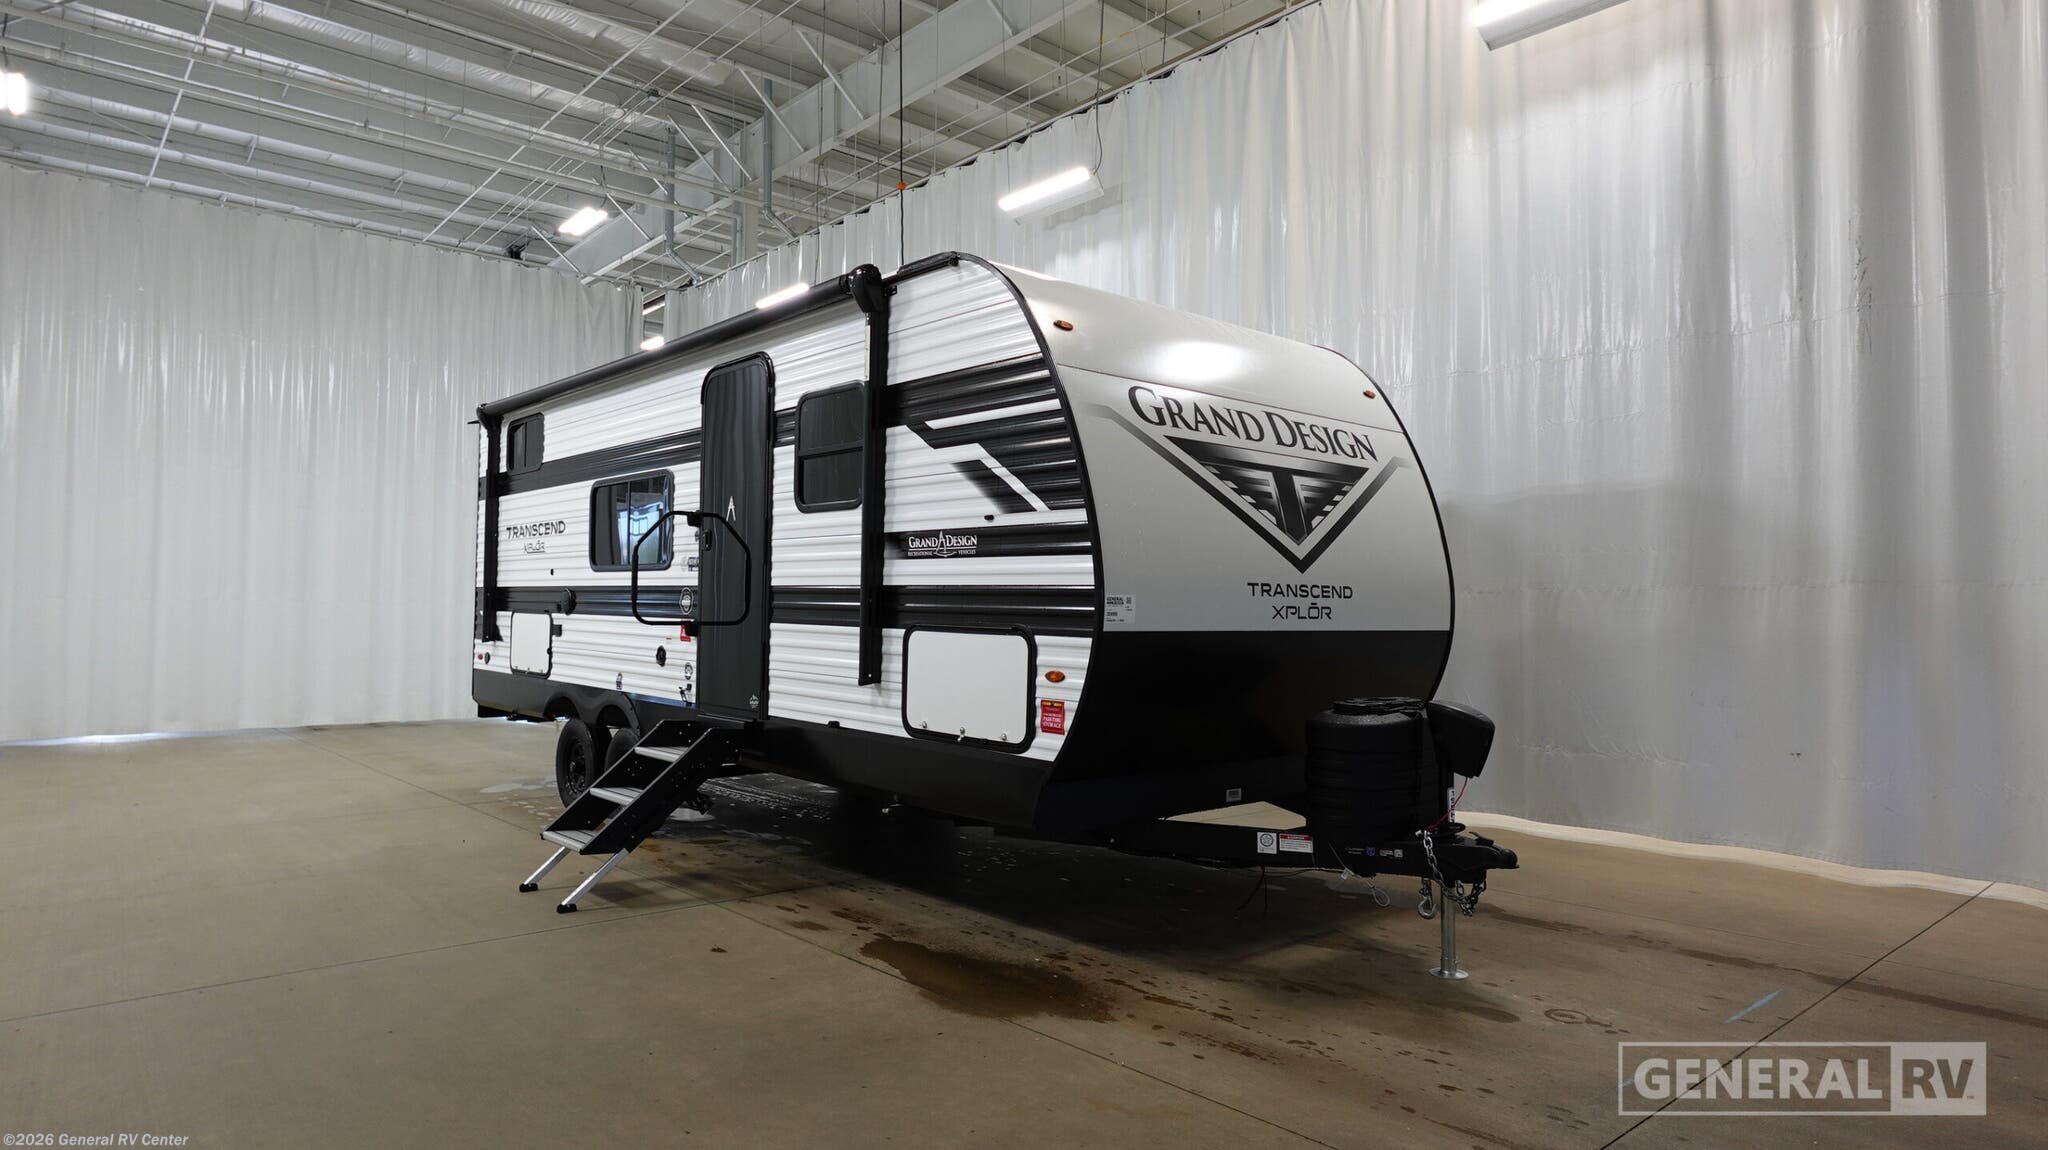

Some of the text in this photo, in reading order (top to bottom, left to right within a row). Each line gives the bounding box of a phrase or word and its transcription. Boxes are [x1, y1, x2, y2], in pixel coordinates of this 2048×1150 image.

[1128, 385, 1378, 462] GRAND DESIGN
[506, 520, 566, 539] TRANSCEND
[908, 534, 977, 548] GRAND DESIGN
[1247, 582, 1353, 599] TRANSCEND
